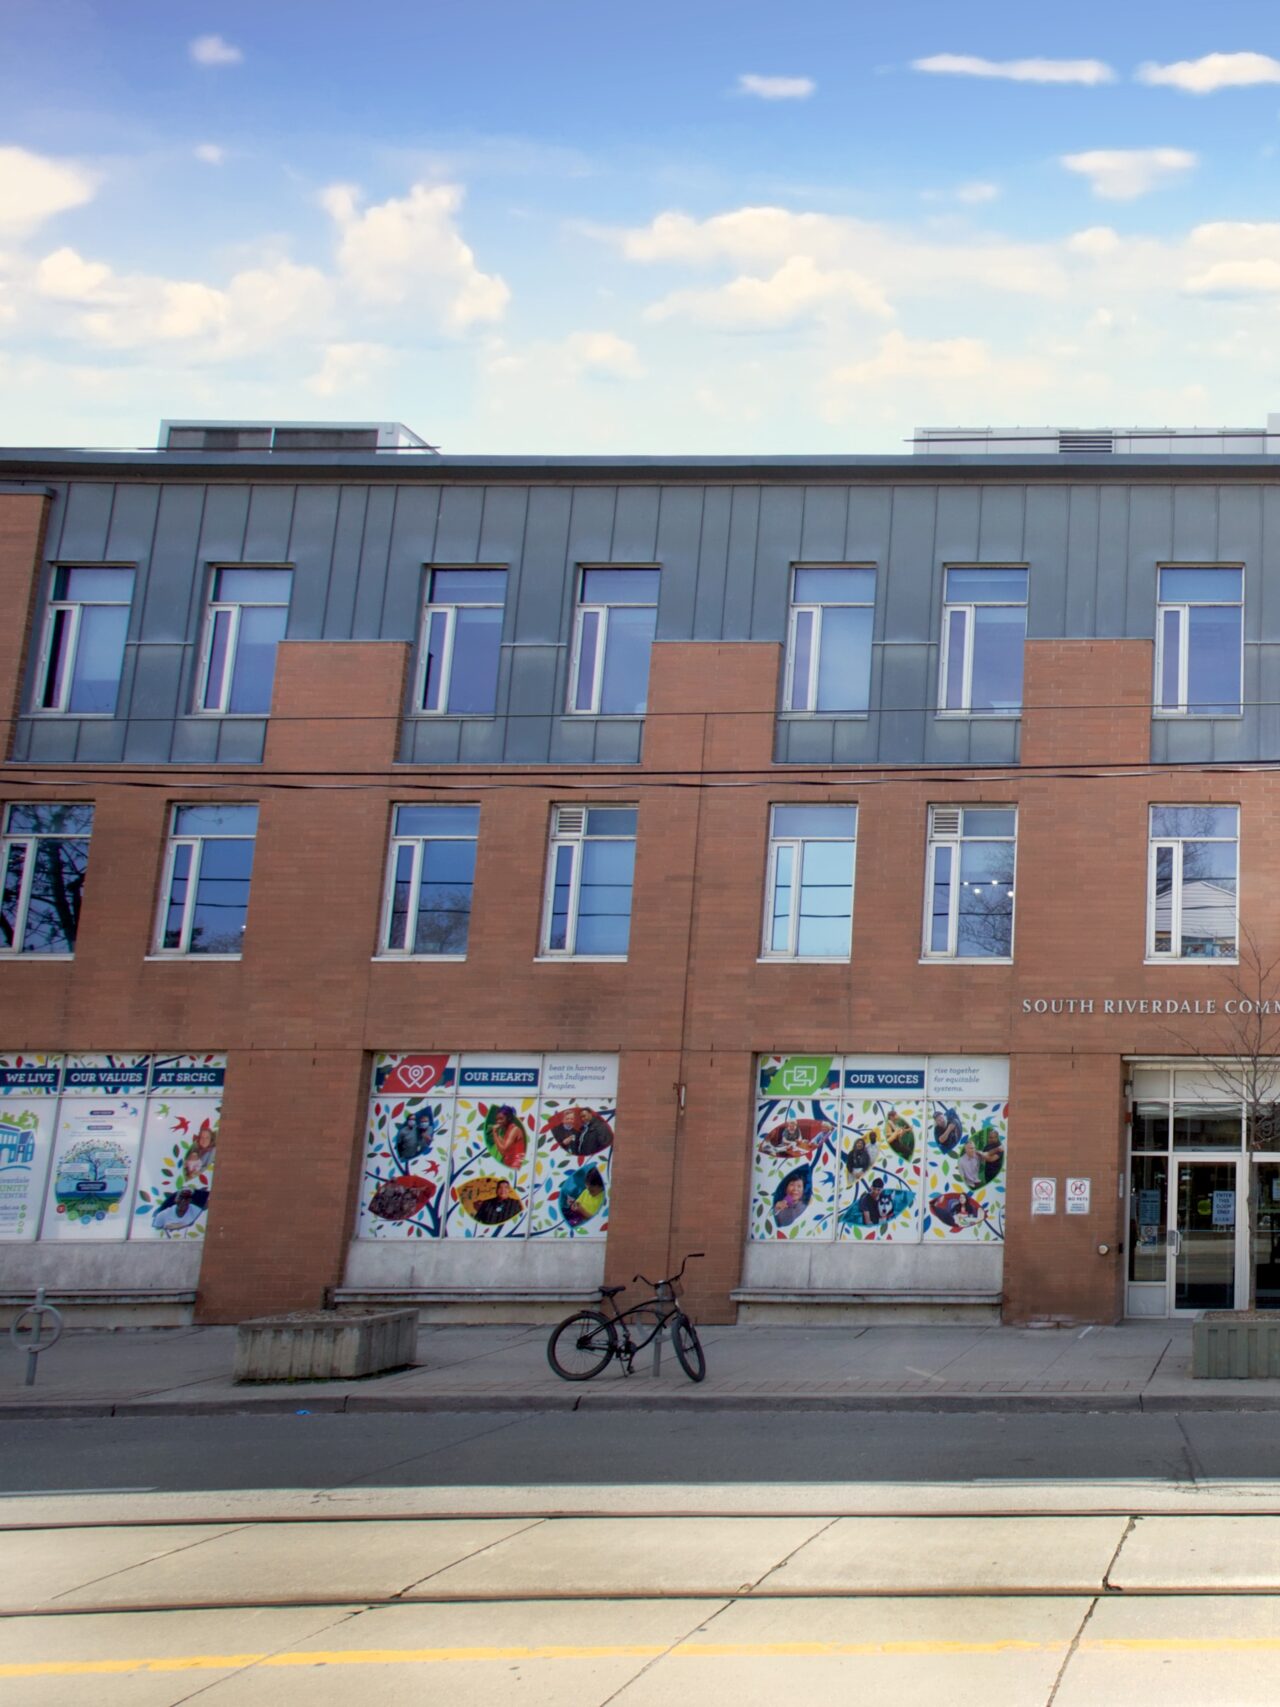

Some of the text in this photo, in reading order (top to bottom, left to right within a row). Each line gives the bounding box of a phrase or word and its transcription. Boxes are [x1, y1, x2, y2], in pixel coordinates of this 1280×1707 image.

[1023, 999, 1094, 1014] SOUTH
[1103, 999, 1216, 1014] RIVERDALE
[949, 1066, 980, 1075] together
[6, 1073, 216, 1083] WE LIVE OUR VALUES AT SRCHC
[464, 1072, 535, 1082] OUR HEARTS
[850, 1074, 919, 1084] OUR VOICES
[945, 1075, 980, 1084] equitable
[0, 1184, 29, 1192] UNITY
